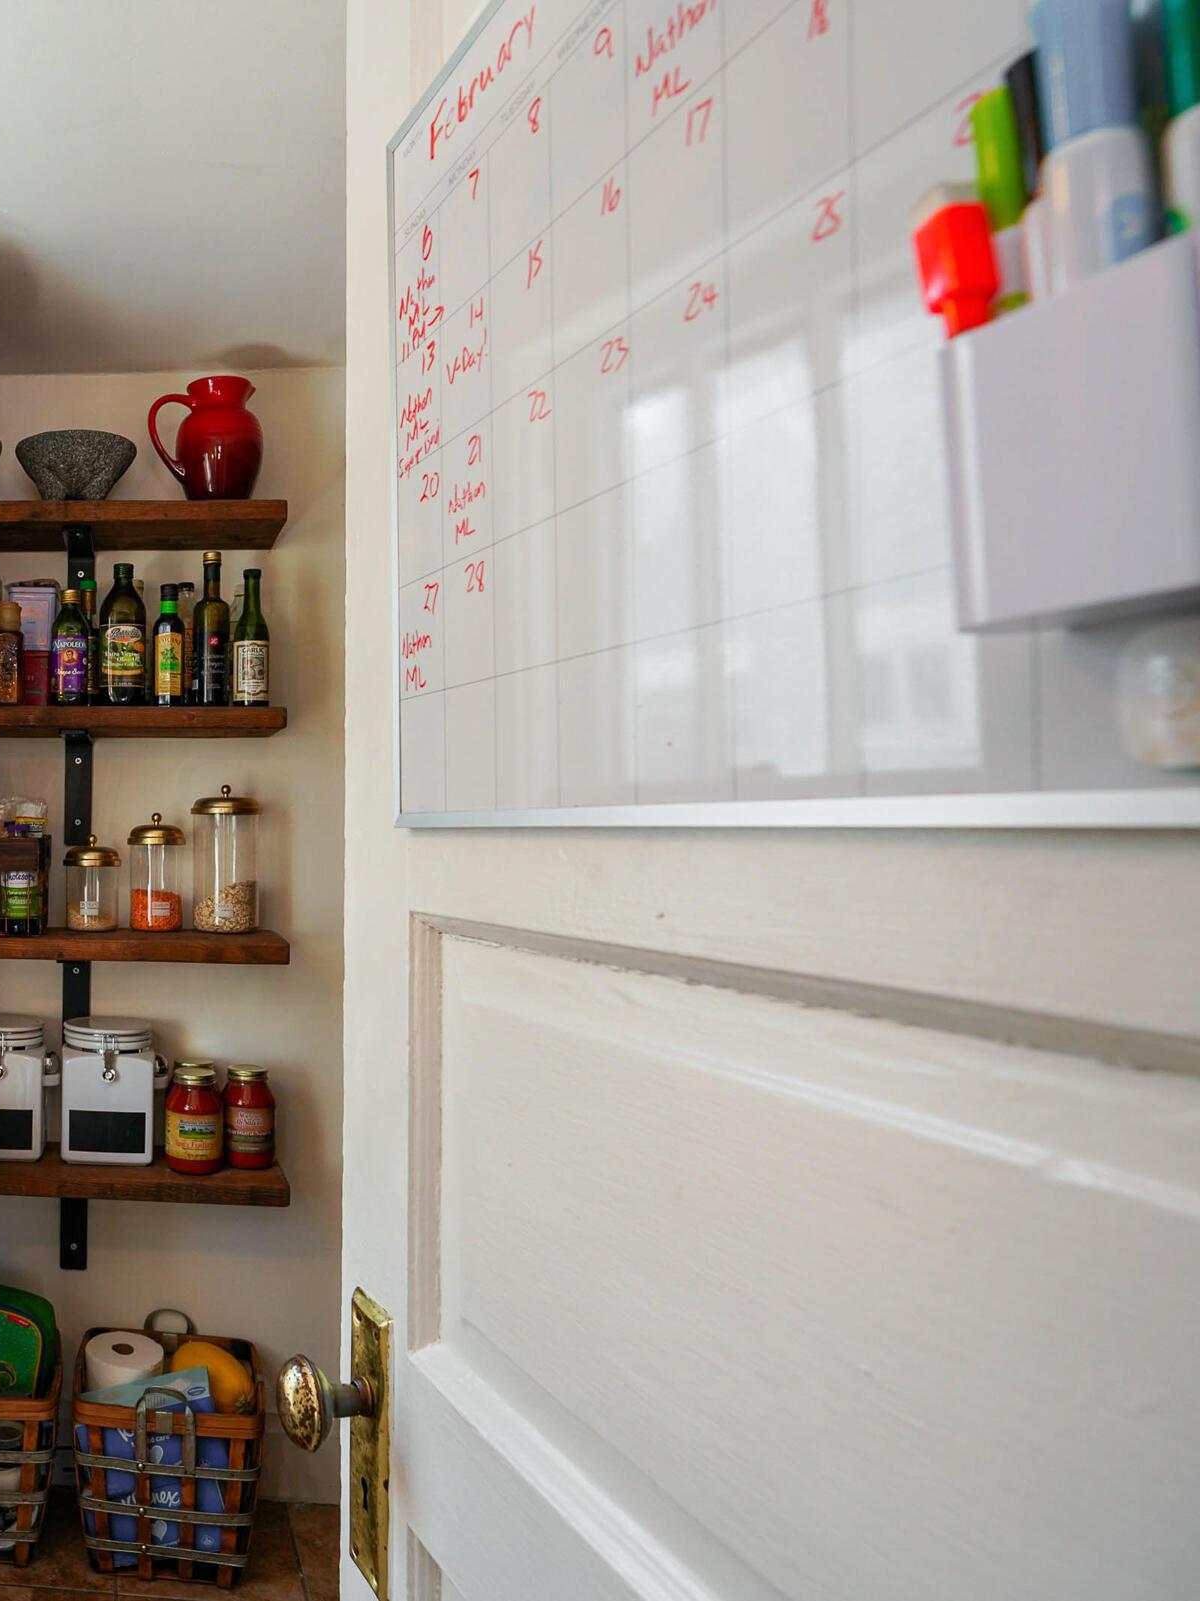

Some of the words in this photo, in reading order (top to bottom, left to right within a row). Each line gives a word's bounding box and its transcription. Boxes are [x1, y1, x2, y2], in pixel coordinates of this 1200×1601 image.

[594, 27, 613, 58] 9
[429, 6, 535, 160] February
[527, 96, 542, 134] 8
[685, 98, 714, 146] 17
[467, 168, 480, 200] 7
[601, 177, 621, 215] 16
[470, 296, 485, 328] 14
[683, 281, 720, 322] 24
[422, 340, 436, 376] 13
[600, 336, 630, 374] 23
[528, 390, 553, 423] 22
[468, 434, 482, 465] 21
[419, 472, 440, 502] 20
[464, 560, 486, 593] 28
[423, 582, 440, 615] 27
